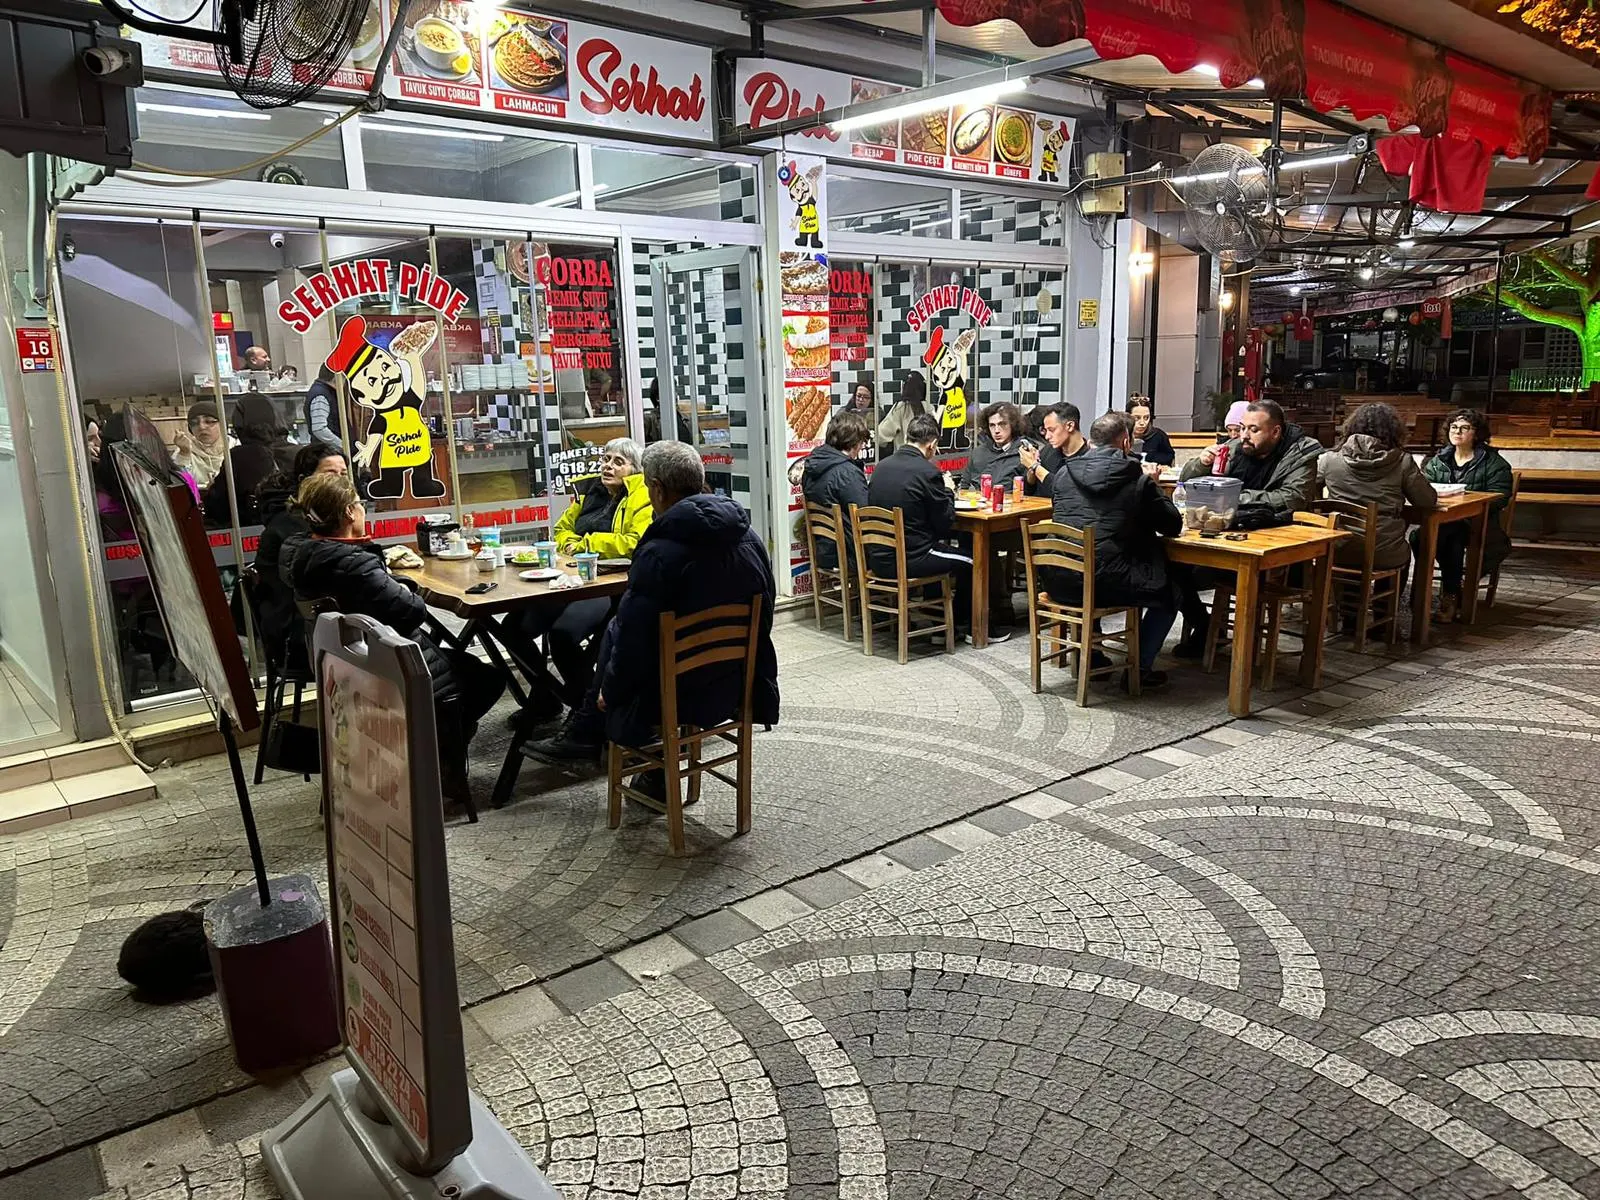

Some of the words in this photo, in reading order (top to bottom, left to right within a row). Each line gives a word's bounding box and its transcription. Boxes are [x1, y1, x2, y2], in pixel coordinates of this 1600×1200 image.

[404, 81, 427, 95] TAVUK
[576, 38, 705, 122] Serhat
[502, 96, 558, 115] LAHMACUN
[828, 270, 873, 294] ORBA
[277, 259, 391, 334] SERHAT
[400, 261, 469, 324] PİDE
[907, 284, 960, 333] SERHAT
[961, 288, 993, 329] PİDE
[29, 340, 50, 355] 16
[552, 447, 587, 463] PAKET
[560, 461, 585, 474] 618
